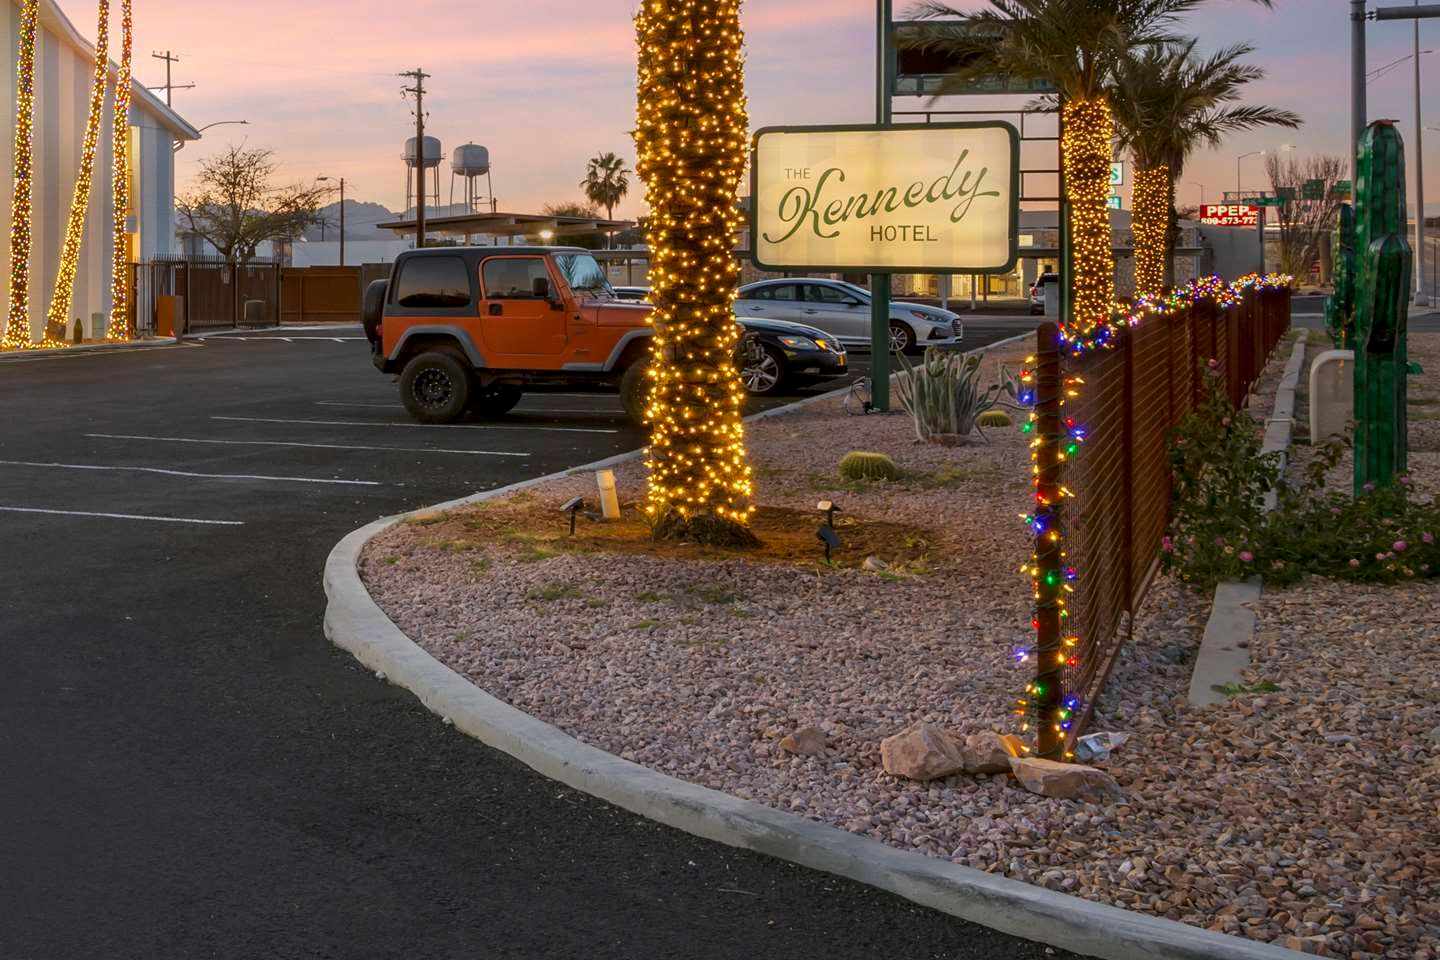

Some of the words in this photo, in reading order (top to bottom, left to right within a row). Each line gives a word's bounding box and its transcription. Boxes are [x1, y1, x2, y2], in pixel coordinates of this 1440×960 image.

[783, 167, 811, 180] THE
[761, 148, 1000, 244] Kennedy
[1206, 205, 1249, 217] PPEP
[870, 225, 938, 242] HOTEL
